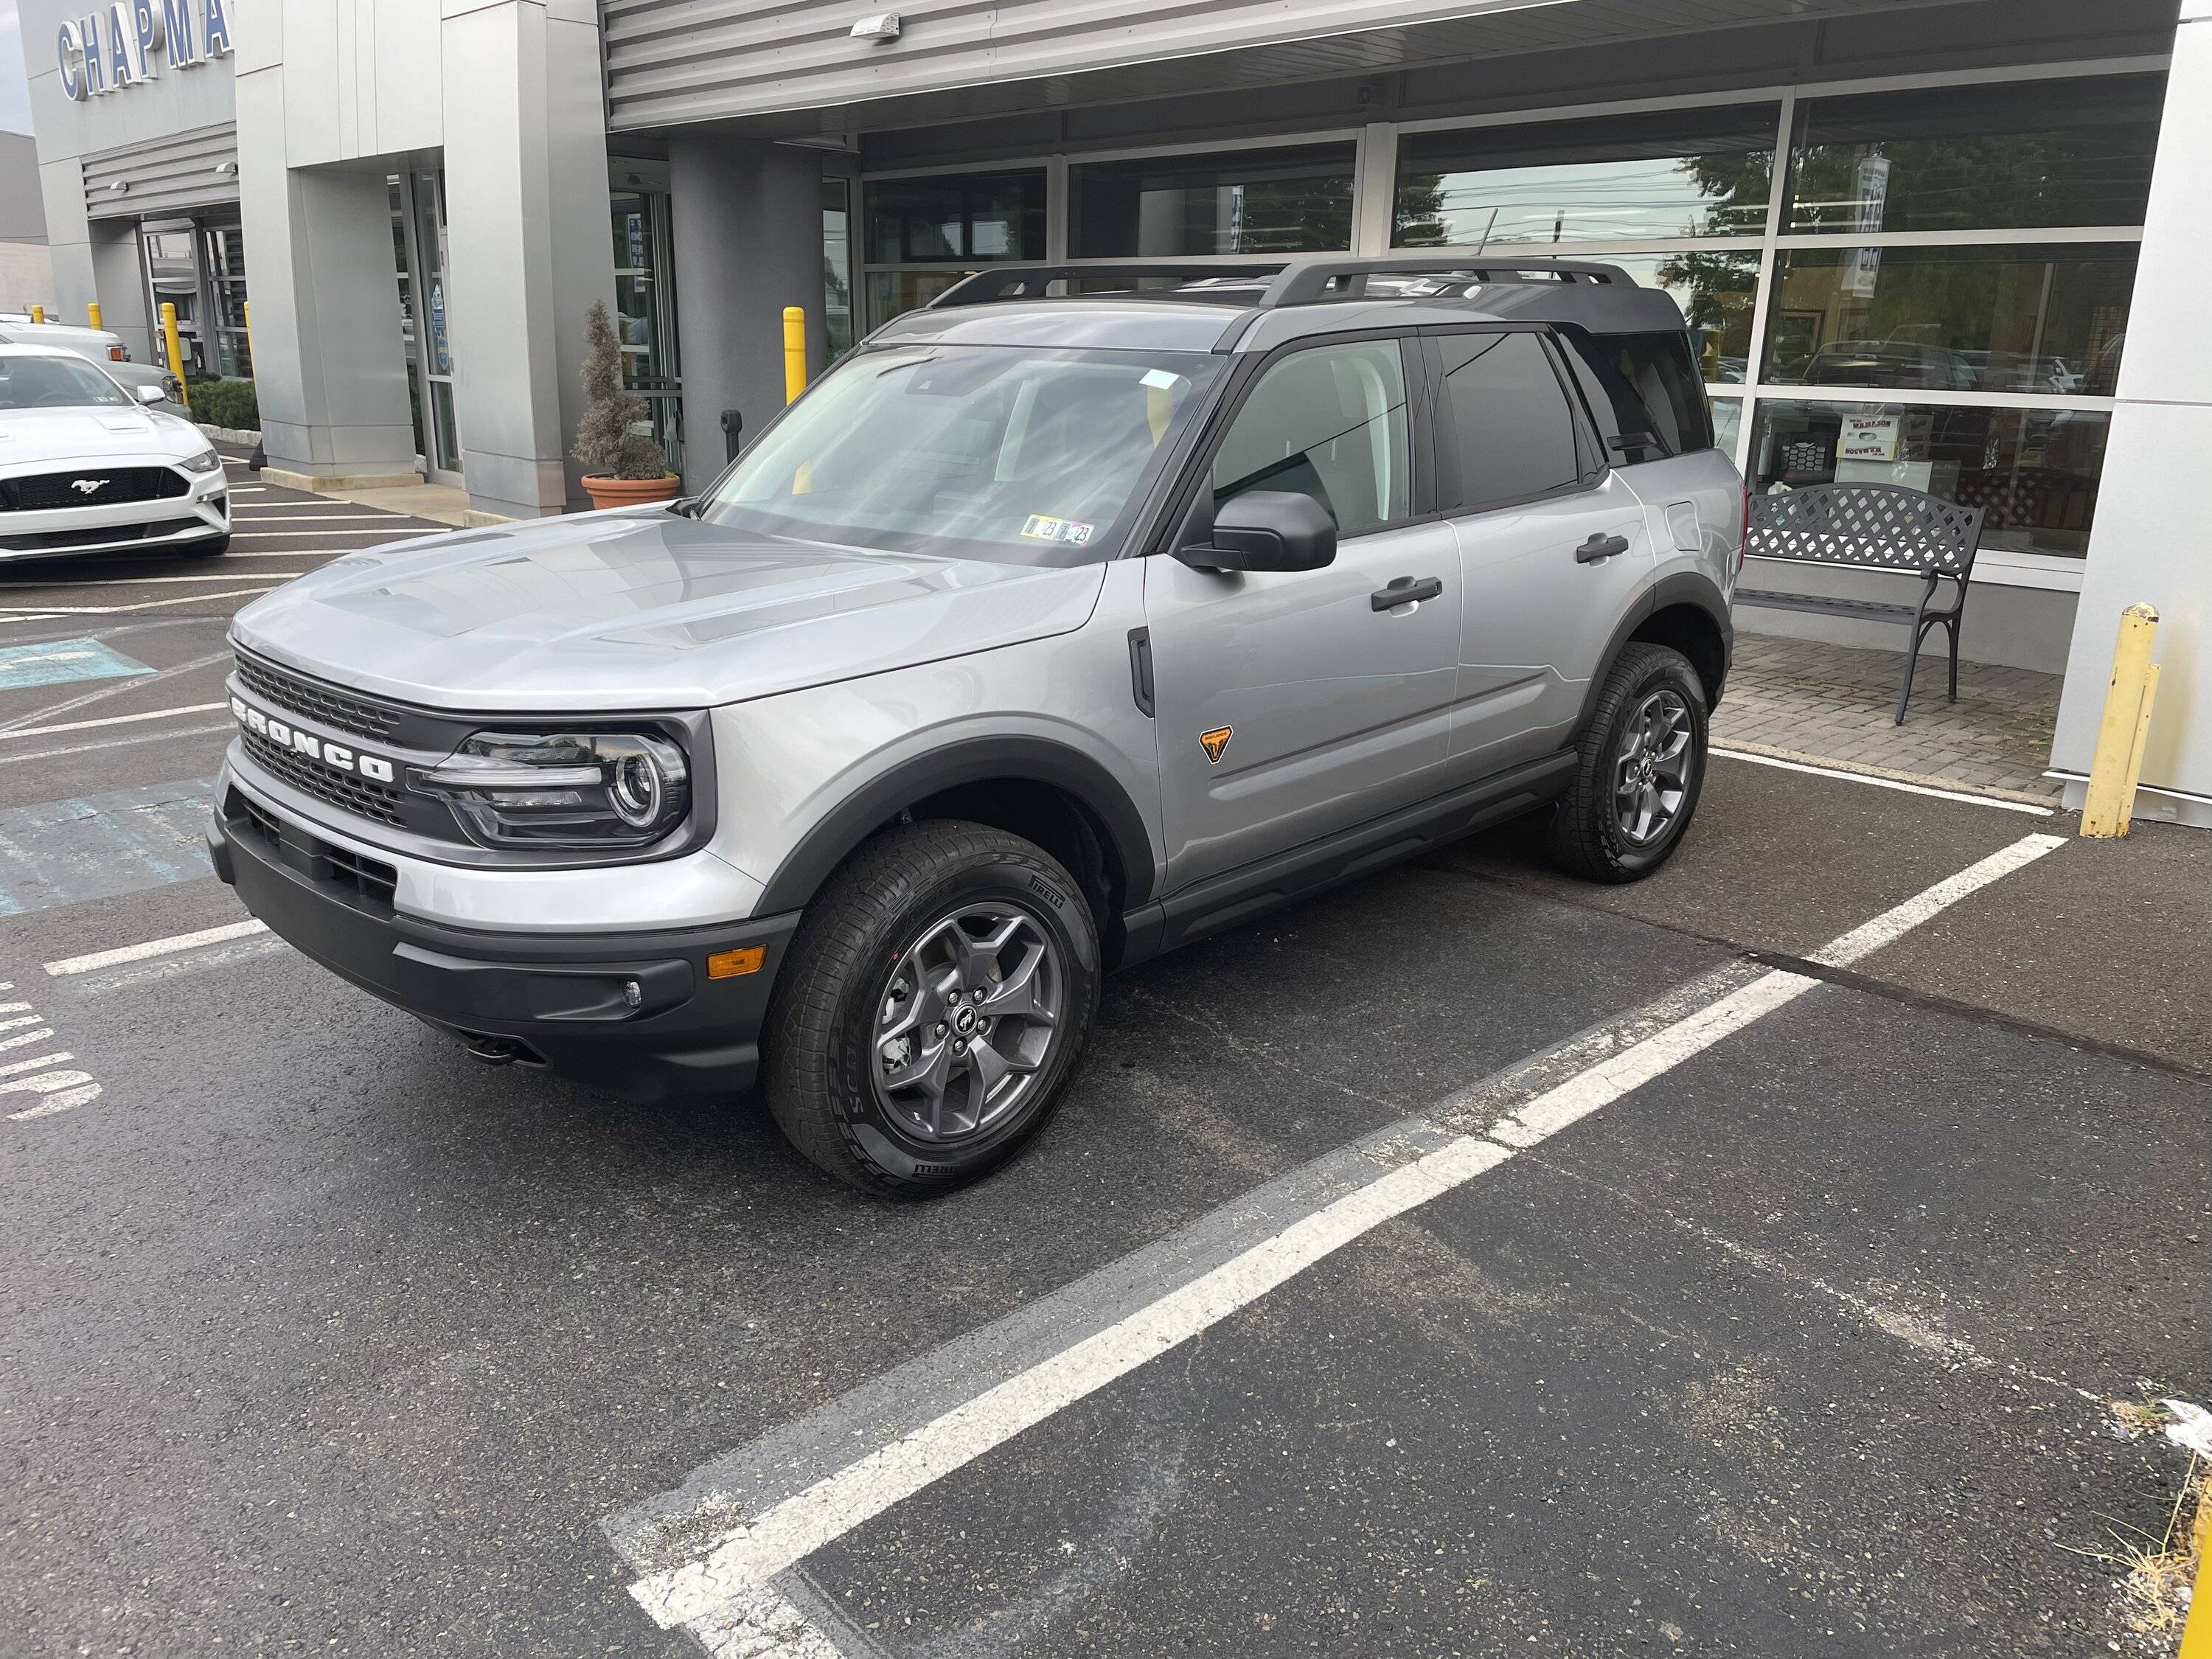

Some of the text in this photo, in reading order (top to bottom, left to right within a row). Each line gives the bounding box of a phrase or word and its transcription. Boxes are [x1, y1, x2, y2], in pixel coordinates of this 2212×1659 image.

[1043, 522, 1057, 535] 23
[1074, 526, 1089, 541] 23
[231, 697, 394, 782] BRONCO
[1029, 874, 1065, 909] PIRELLI
